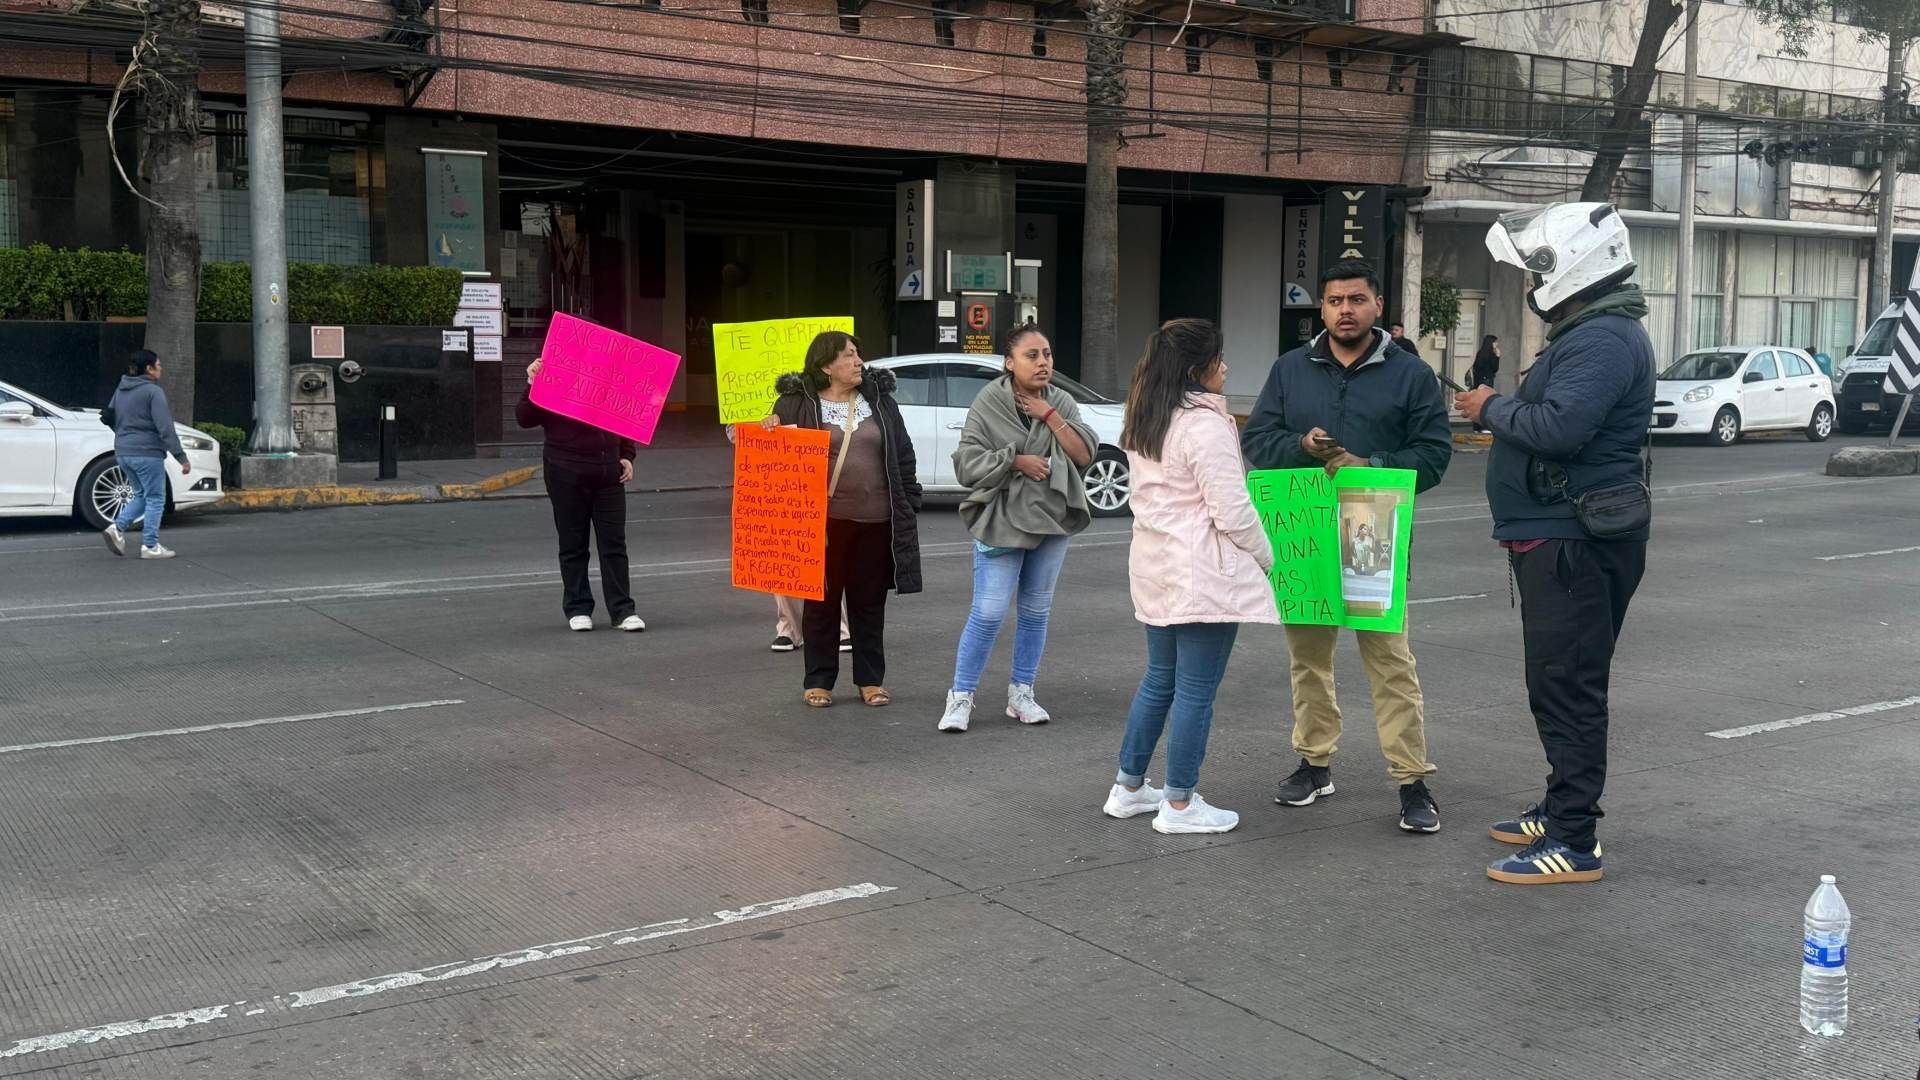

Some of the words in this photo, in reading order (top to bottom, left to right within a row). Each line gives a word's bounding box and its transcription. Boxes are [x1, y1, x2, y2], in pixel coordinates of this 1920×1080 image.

[905, 188, 914, 266] SALIDA
[1339, 190, 1366, 258] VILLA
[1296, 208, 1308, 279] ENTRADA
[553, 317, 657, 374] EXIGIMOS
[723, 329, 752, 351] TE
[760, 350, 792, 365] DE
[633, 375, 656, 395] de
[567, 376, 659, 421] AUTORIDADES
[722, 390, 762, 406] EDITH
[783, 436, 791, 455] te
[738, 456, 752, 473] de
[792, 464, 800, 472] a
[804, 464, 816, 475] la
[1248, 476, 1273, 503] TE
[1288, 473, 1333, 500] AMO
[1280, 536, 1321, 564] UNA
[750, 560, 800, 579] REGRESO
